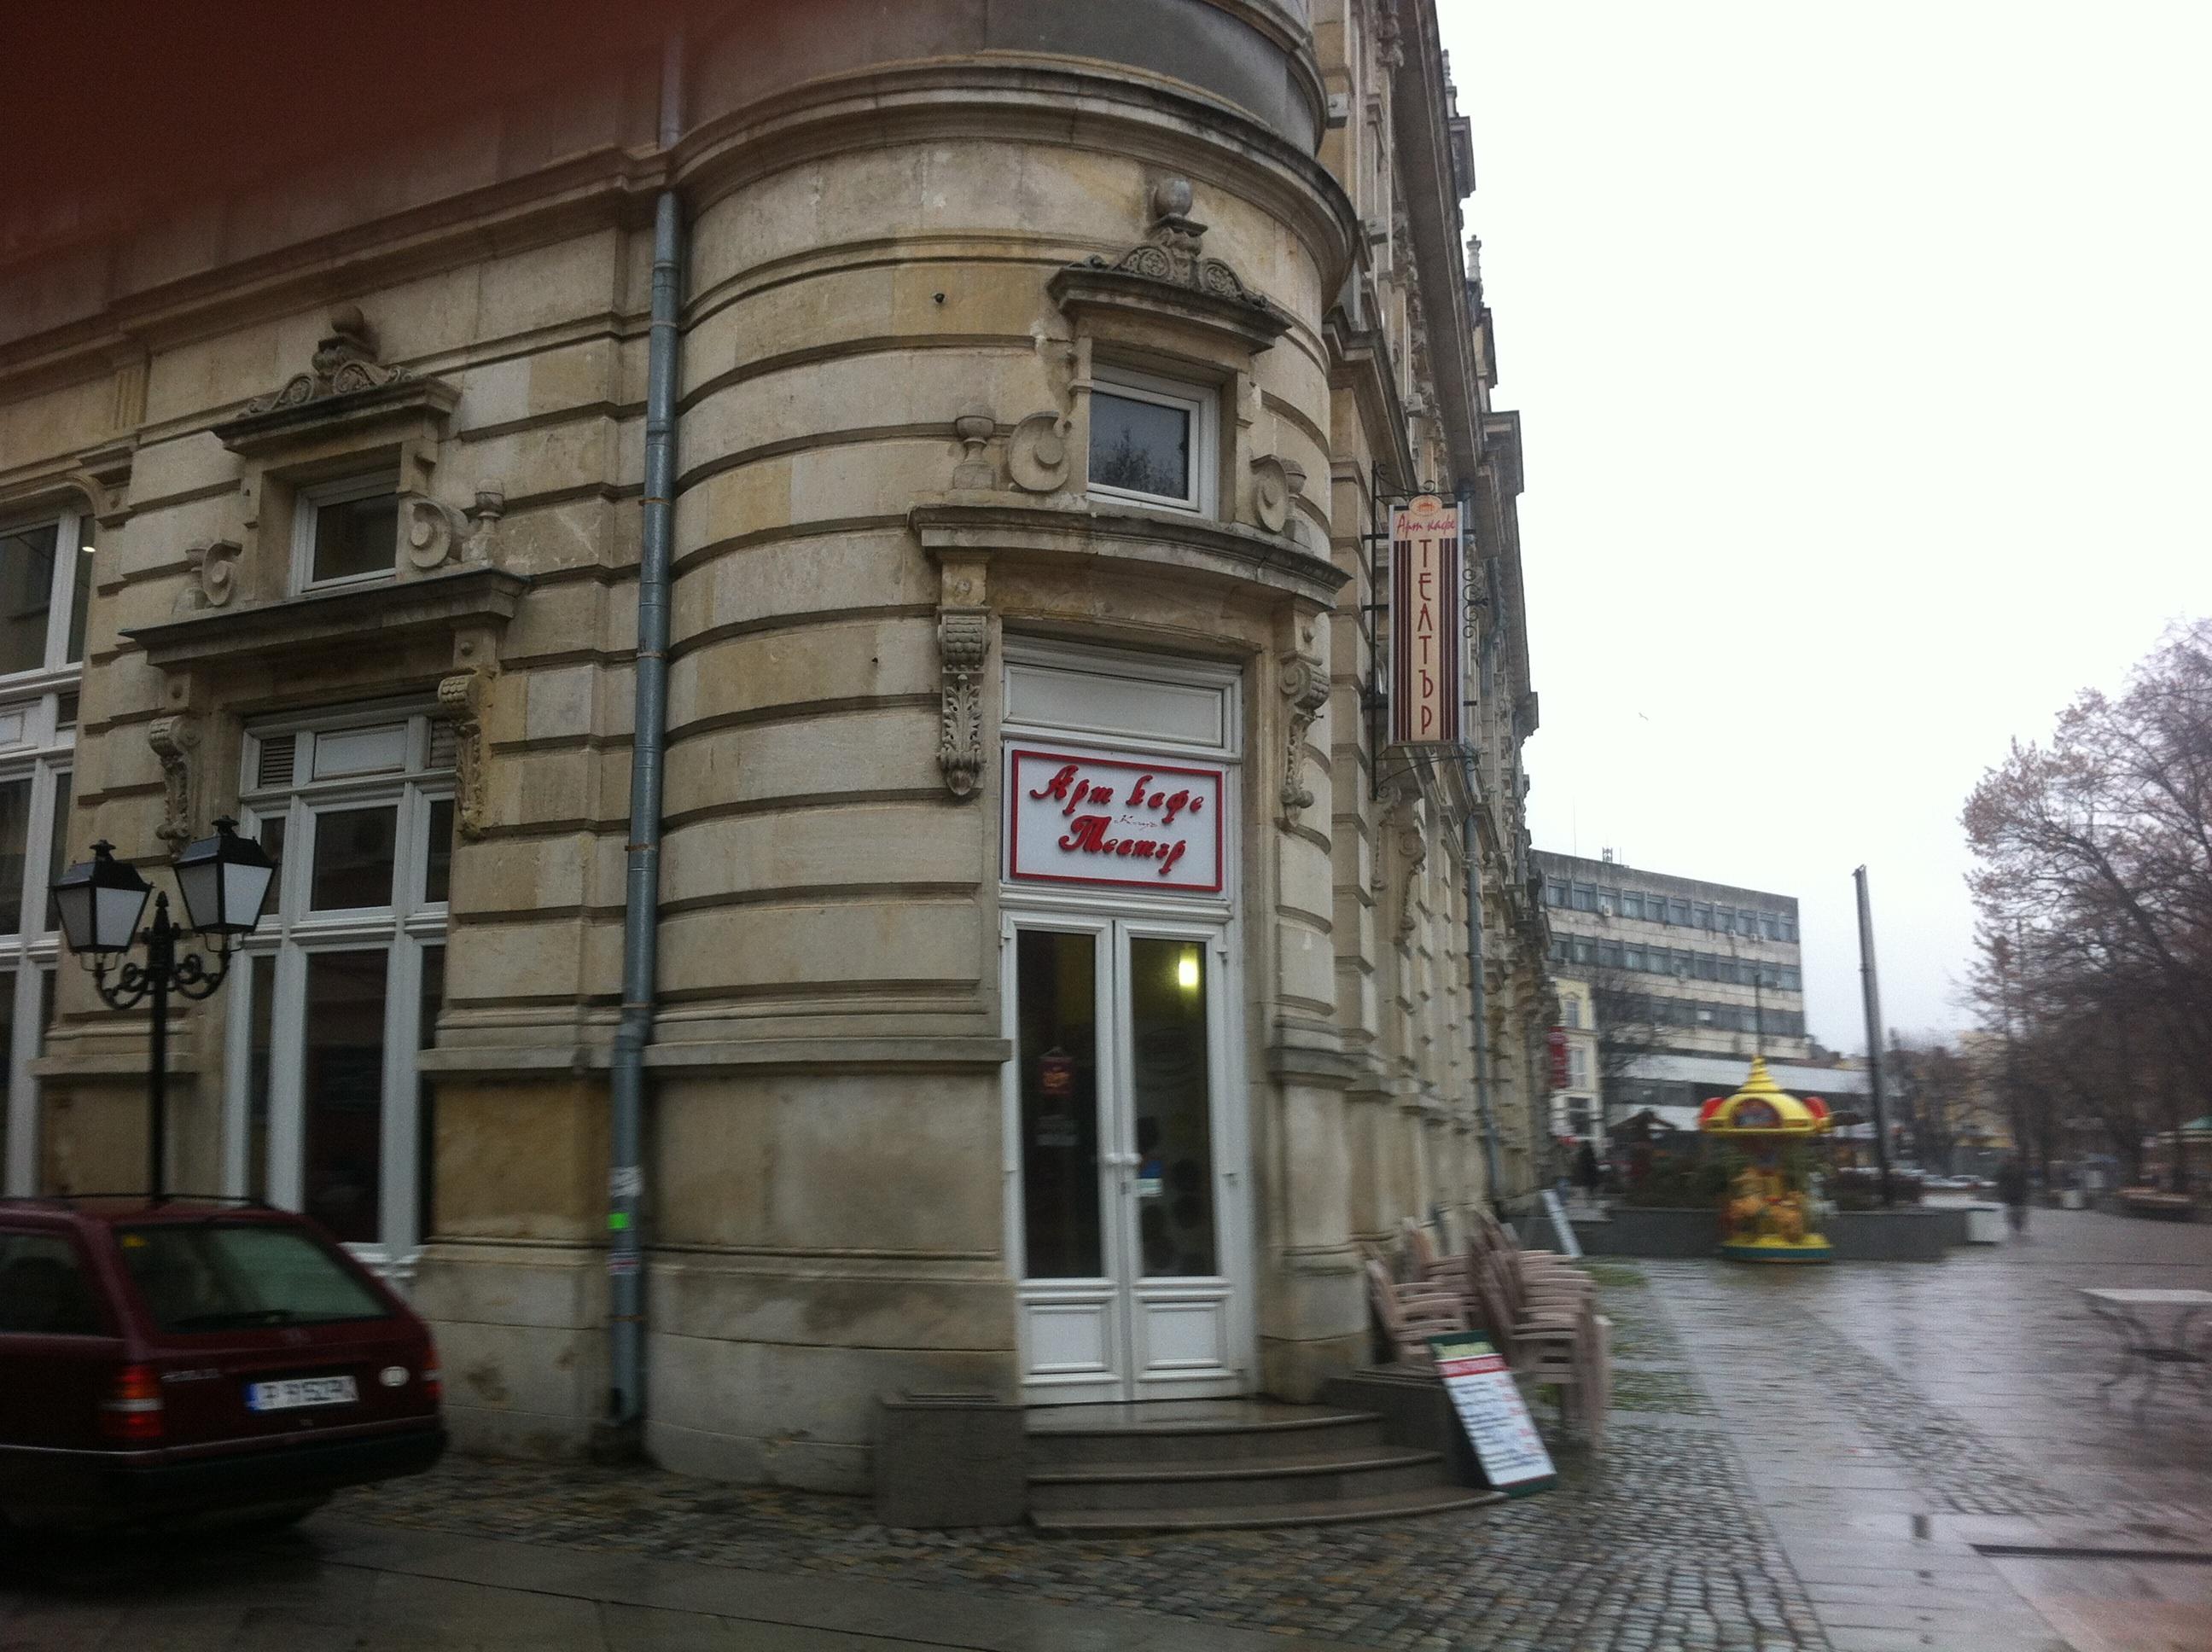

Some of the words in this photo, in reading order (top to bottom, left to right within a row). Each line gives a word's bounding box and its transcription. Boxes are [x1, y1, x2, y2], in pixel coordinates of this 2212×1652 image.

[1417, 538, 1434, 735] ТЕАТЪР
[1029, 765, 1114, 816] Арт
[1058, 815, 1186, 875] Театър
